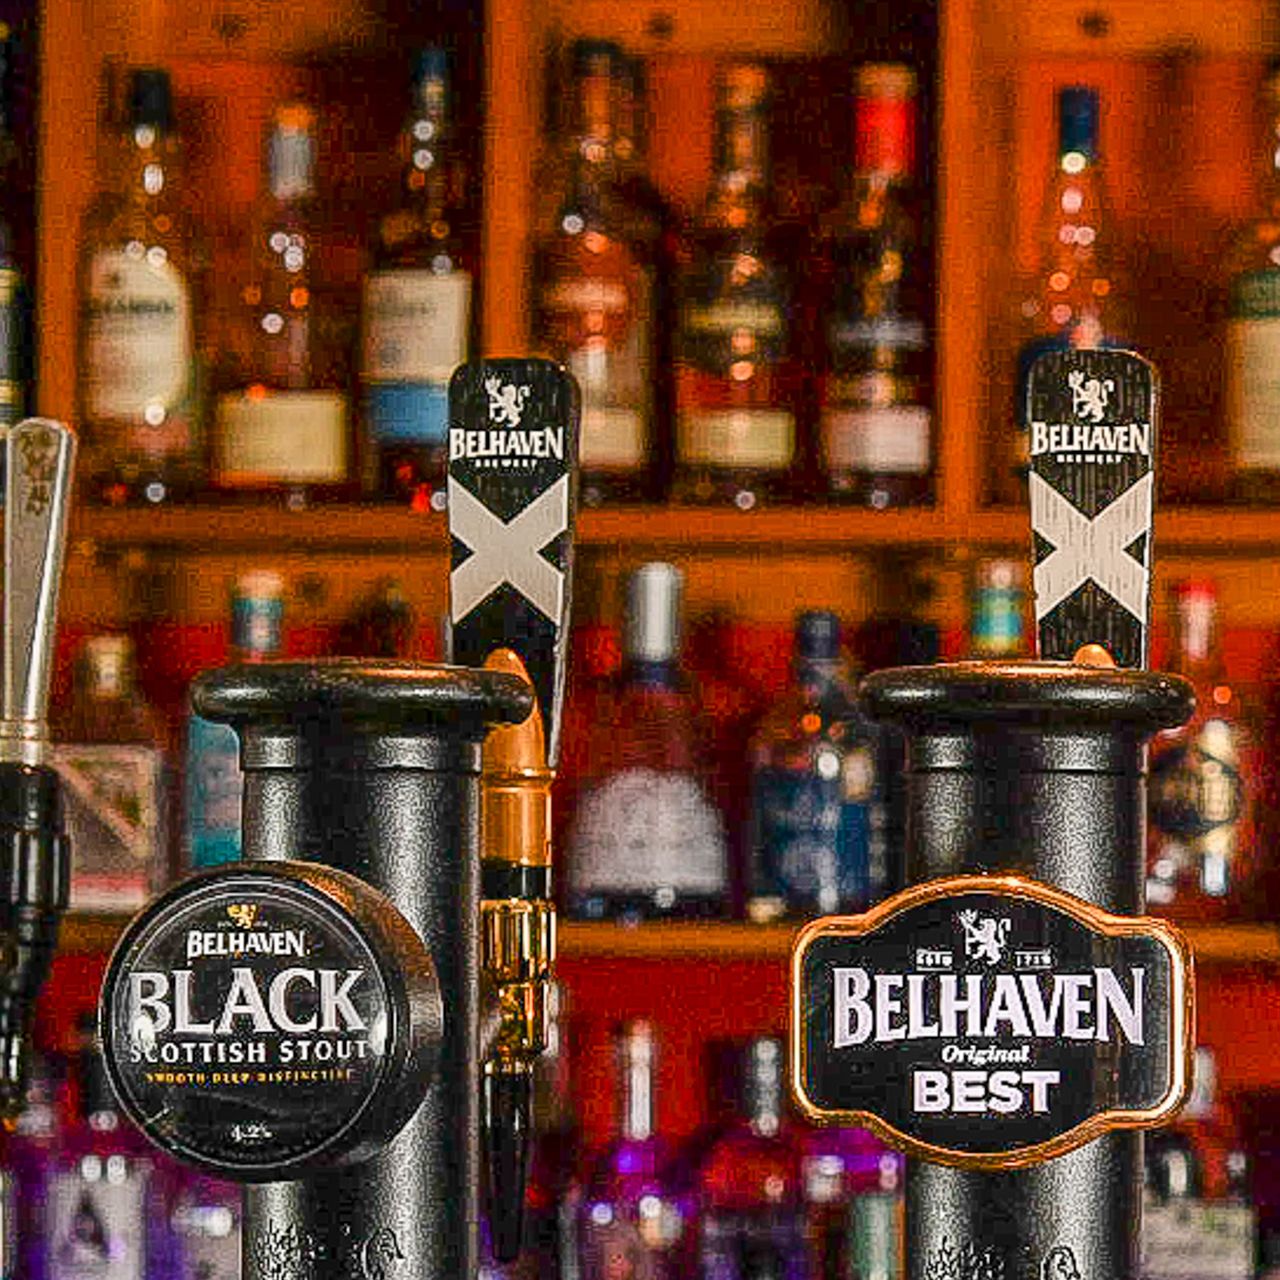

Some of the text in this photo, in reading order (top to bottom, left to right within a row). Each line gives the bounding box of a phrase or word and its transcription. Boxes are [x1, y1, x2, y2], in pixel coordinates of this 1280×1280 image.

[449, 426, 564, 461] BELHAVEN
[1030, 421, 1150, 456] BELHAVEN
[186, 929, 306, 958] BELHAVEN
[128, 966, 369, 1035] BLACK
[833, 966, 1146, 1049] BELHAVEN
[129, 1039, 368, 1064] SCOTTISH STOUT
[941, 1044, 1031, 1067] Original
[912, 1070, 1061, 1114] BEST
